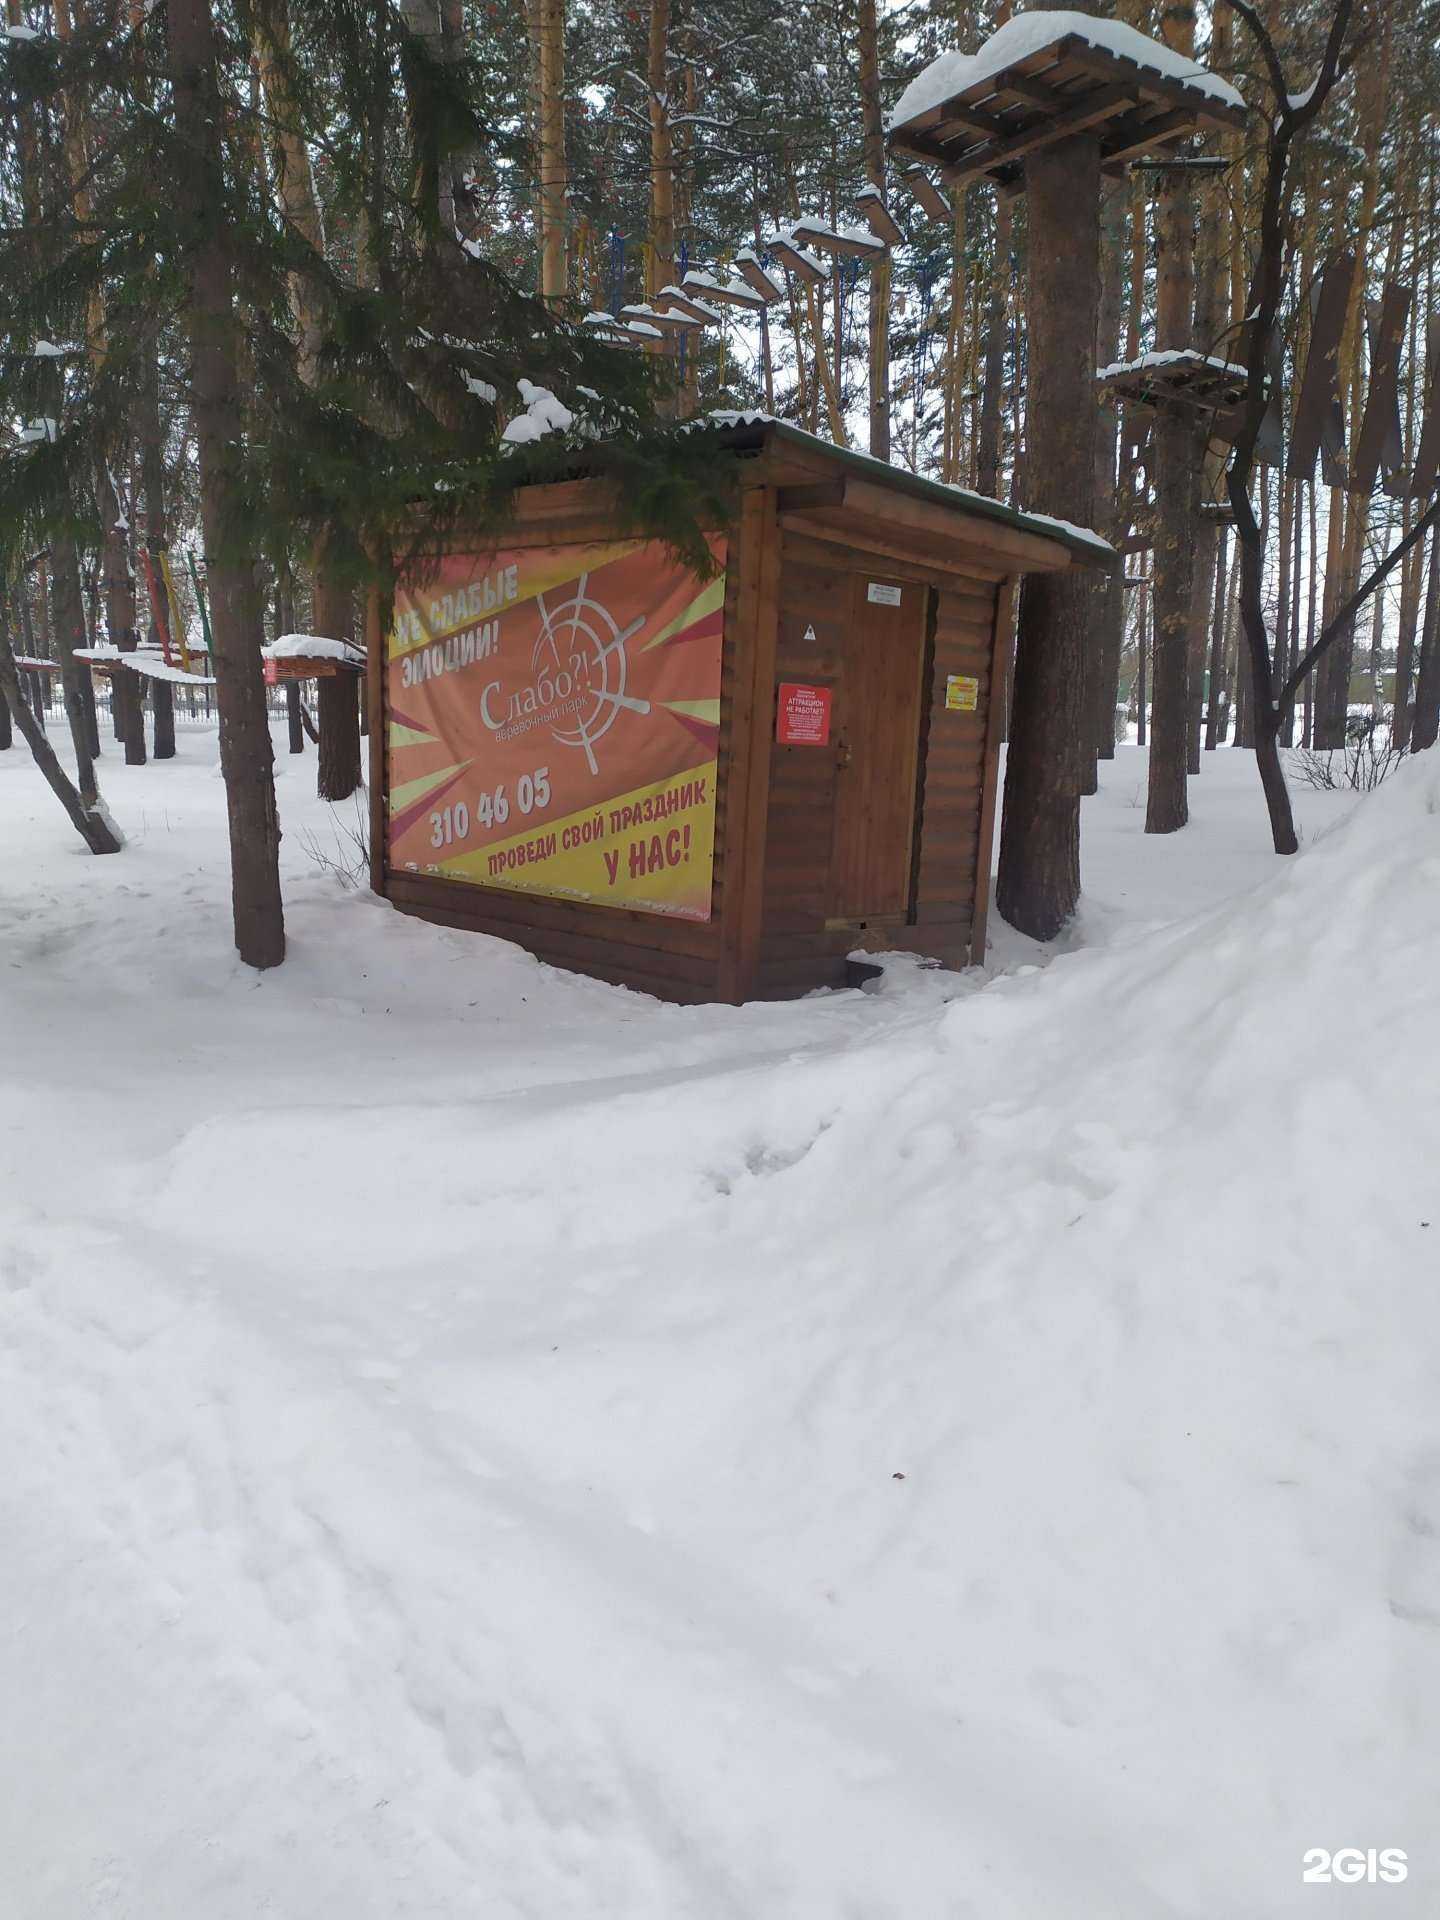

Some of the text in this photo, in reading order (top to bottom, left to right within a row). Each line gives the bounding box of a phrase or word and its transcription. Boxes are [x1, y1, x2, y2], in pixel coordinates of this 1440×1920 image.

[431, 564, 519, 633] СЛАБЫЕ
[401, 619, 500, 689] ЭМОЦИИ!
[480, 650, 592, 730] Слабо?!
[561, 695, 588, 717] парк
[430, 767, 551, 849] 310 46 05
[487, 778, 707, 876] ПРОВЕДИ СВОЙ ПРАЗДНИК
[603, 824, 691, 886] У НАС!
